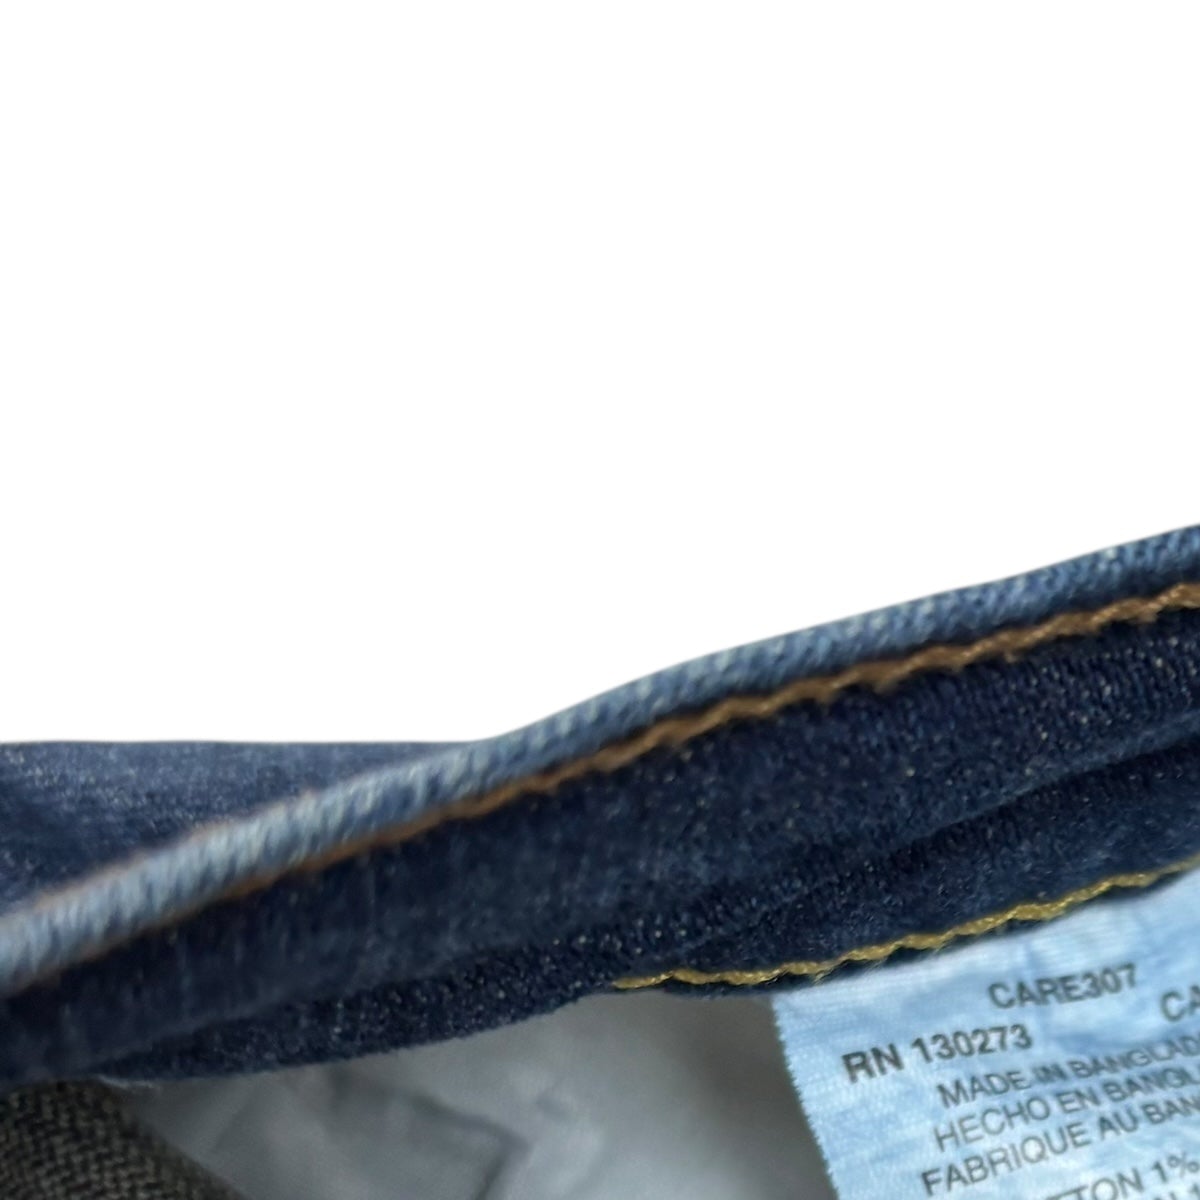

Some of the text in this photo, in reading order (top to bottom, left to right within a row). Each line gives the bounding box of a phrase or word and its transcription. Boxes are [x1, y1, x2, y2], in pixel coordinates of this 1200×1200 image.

[988, 963, 1138, 1010] CARE307
[842, 1024, 1033, 1083] RN 130273
[936, 1070, 1028, 1109] MADE
[1033, 1064, 1066, 1085] IN
[934, 1097, 1052, 1151] HECHO
[1061, 1086, 1101, 1115] EN
[921, 1122, 1092, 1196] FABRIQUE
[1100, 1105, 1138, 1139] AU
[1151, 1153, 1200, 1184] 1%
